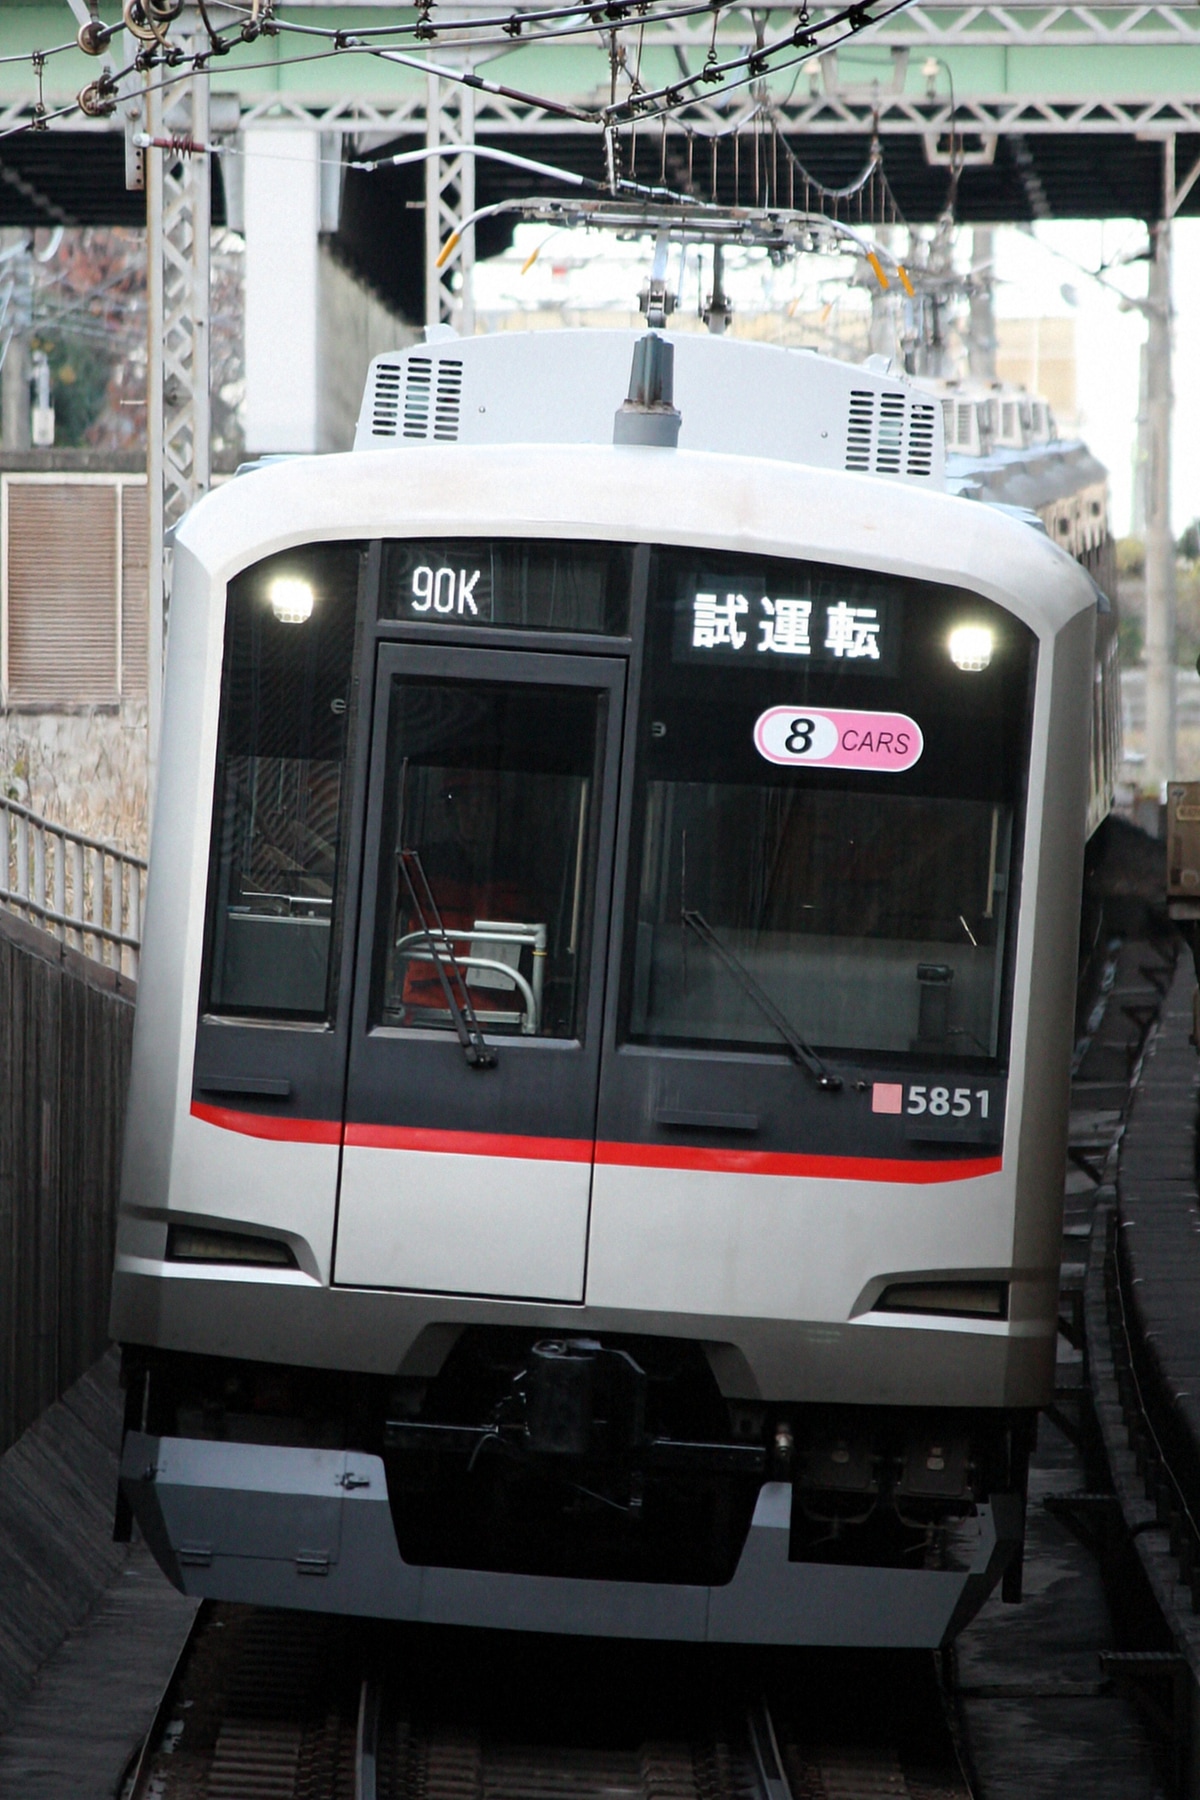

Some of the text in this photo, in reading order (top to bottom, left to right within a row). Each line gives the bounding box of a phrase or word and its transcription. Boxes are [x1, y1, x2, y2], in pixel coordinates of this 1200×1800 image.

[411, 566, 481, 616] 90K
[692, 593, 880, 660] 試運転
[785, 718, 911, 755] 8 CARS
[907, 1085, 989, 1119] 5851
